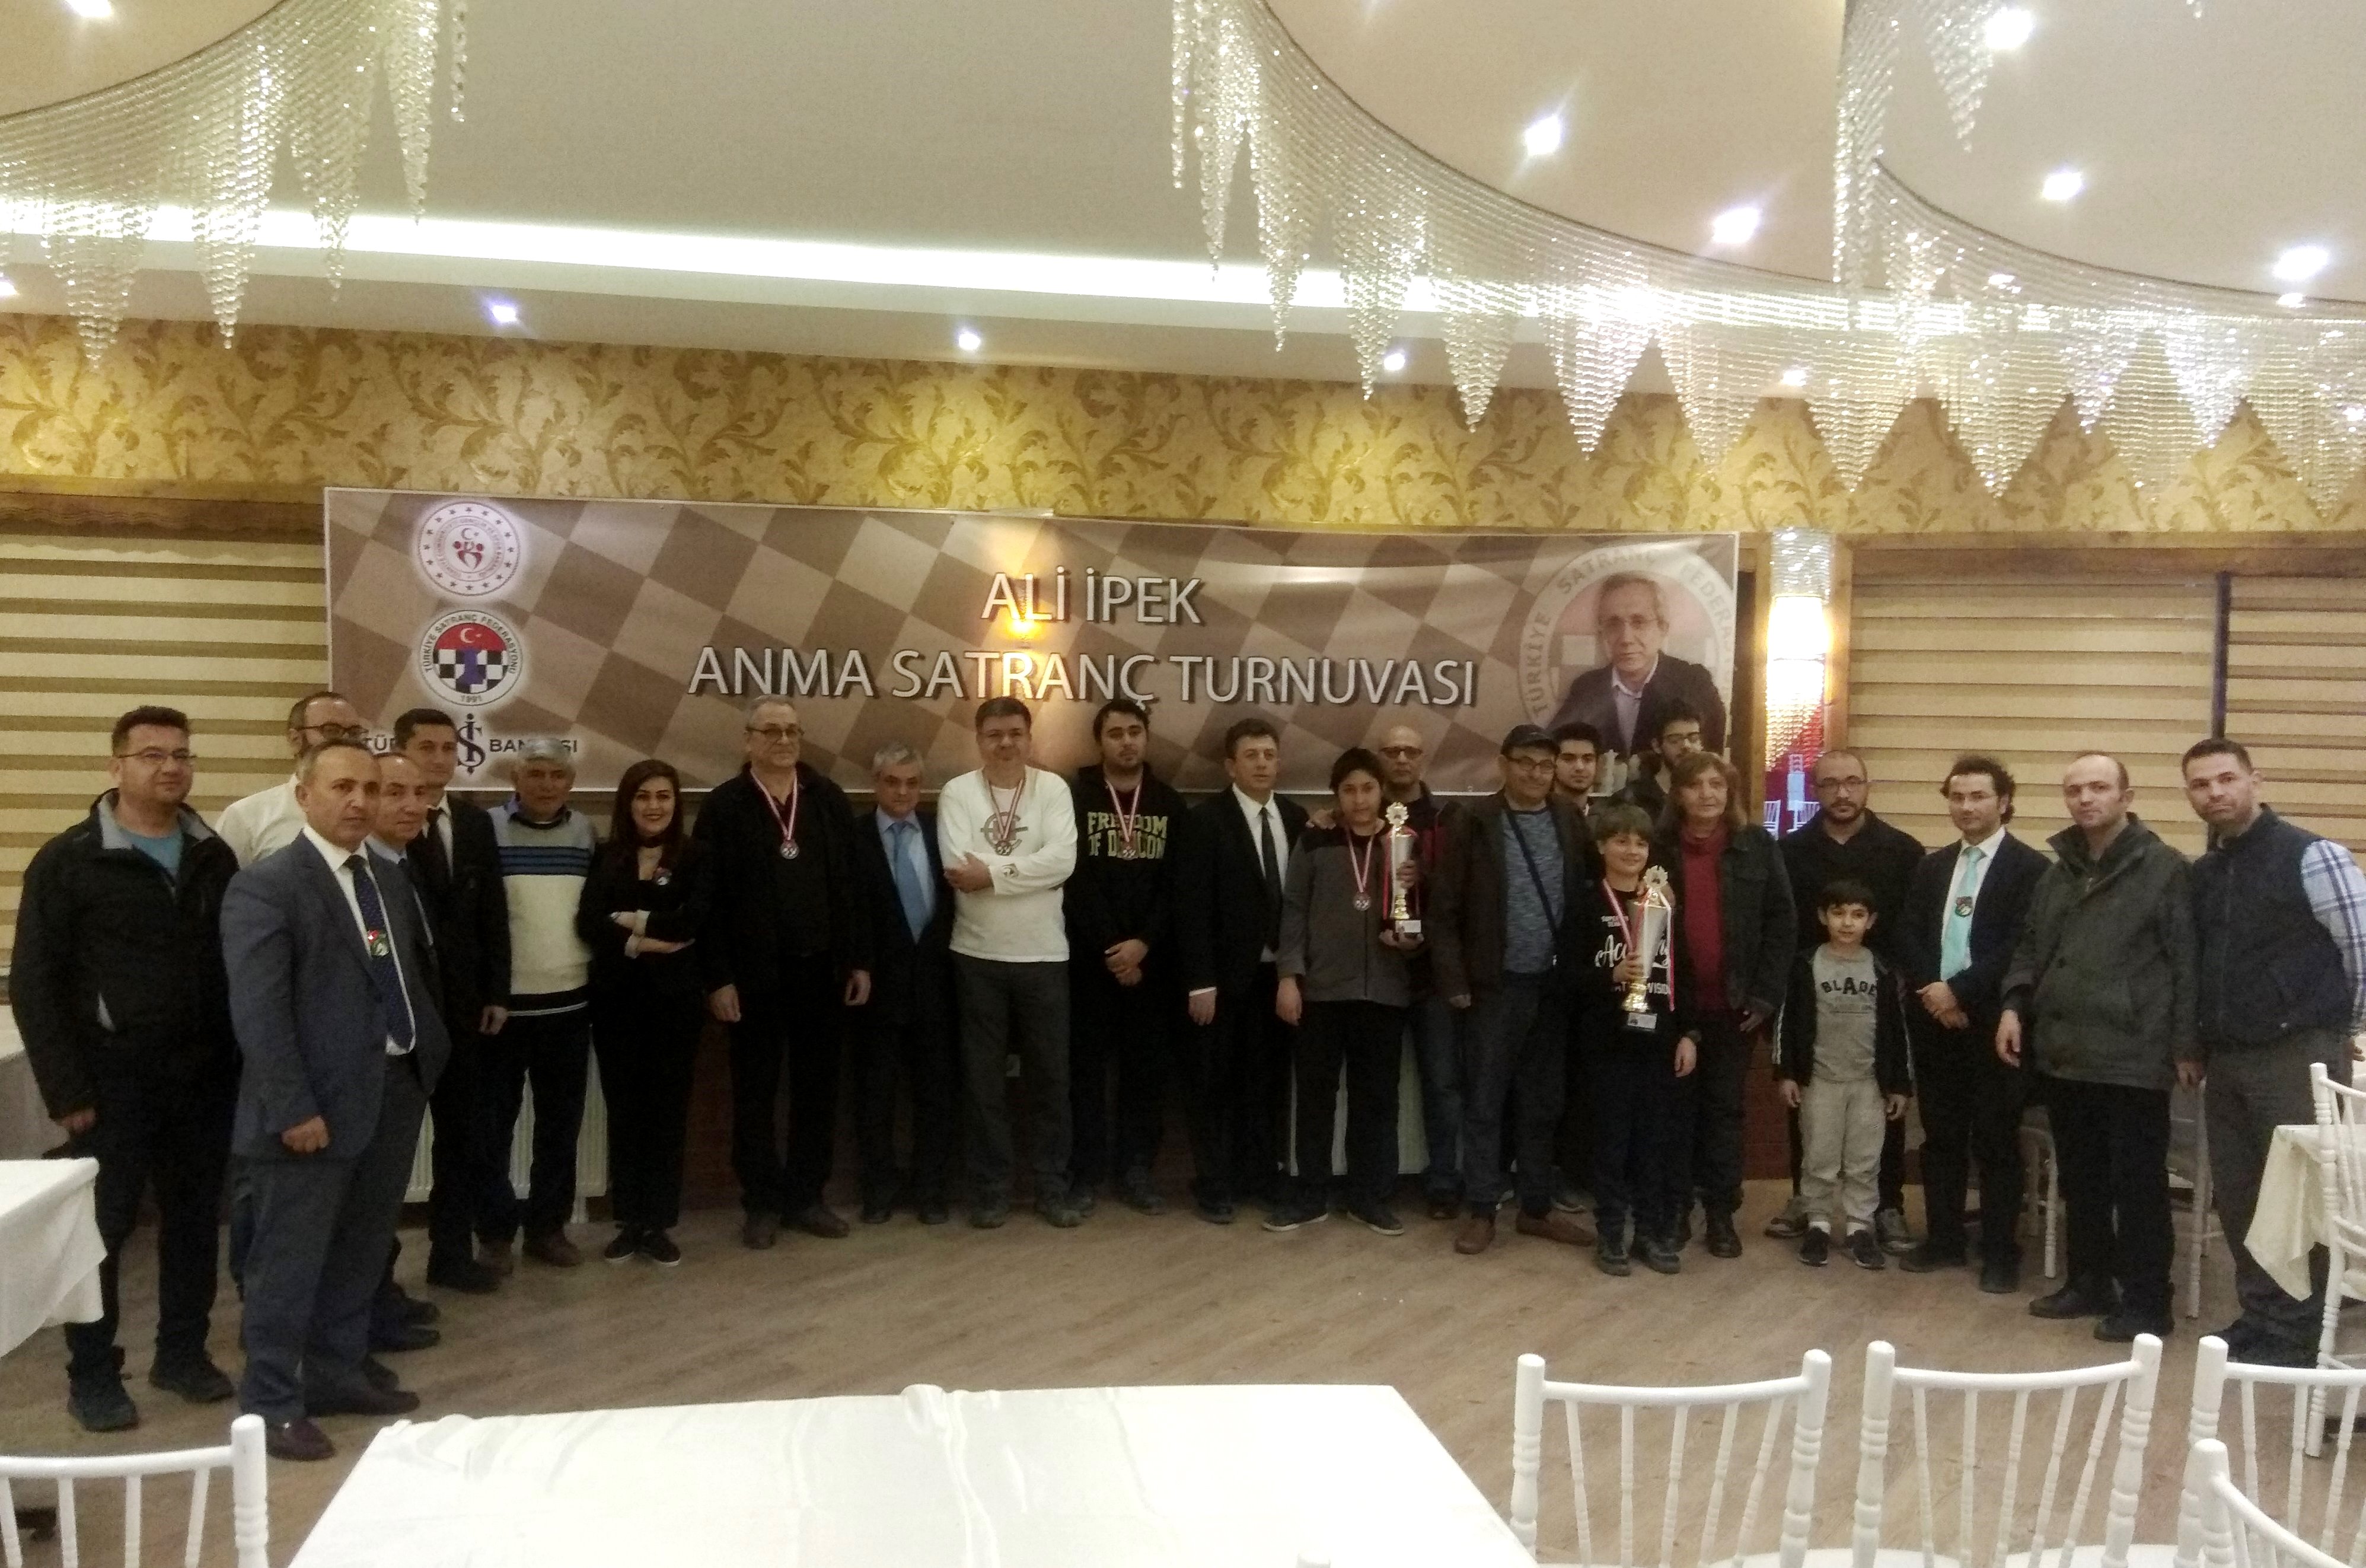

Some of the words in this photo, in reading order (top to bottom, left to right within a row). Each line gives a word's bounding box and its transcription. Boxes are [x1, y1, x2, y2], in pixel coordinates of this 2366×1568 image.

[981, 565, 1066, 623] ALİ
[1085, 568, 1201, 624] İPEK
[423, 633, 437, 673] TÜRKİYE
[687, 646, 874, 697] ANMA
[892, 650, 1155, 709] SATRANÇ
[1169, 656, 1474, 706] TURNUVASI
[1526, 612, 1551, 715] TÜRKİYE
[461, 694, 482, 703] 1991
[490, 738, 578, 753] BASI
